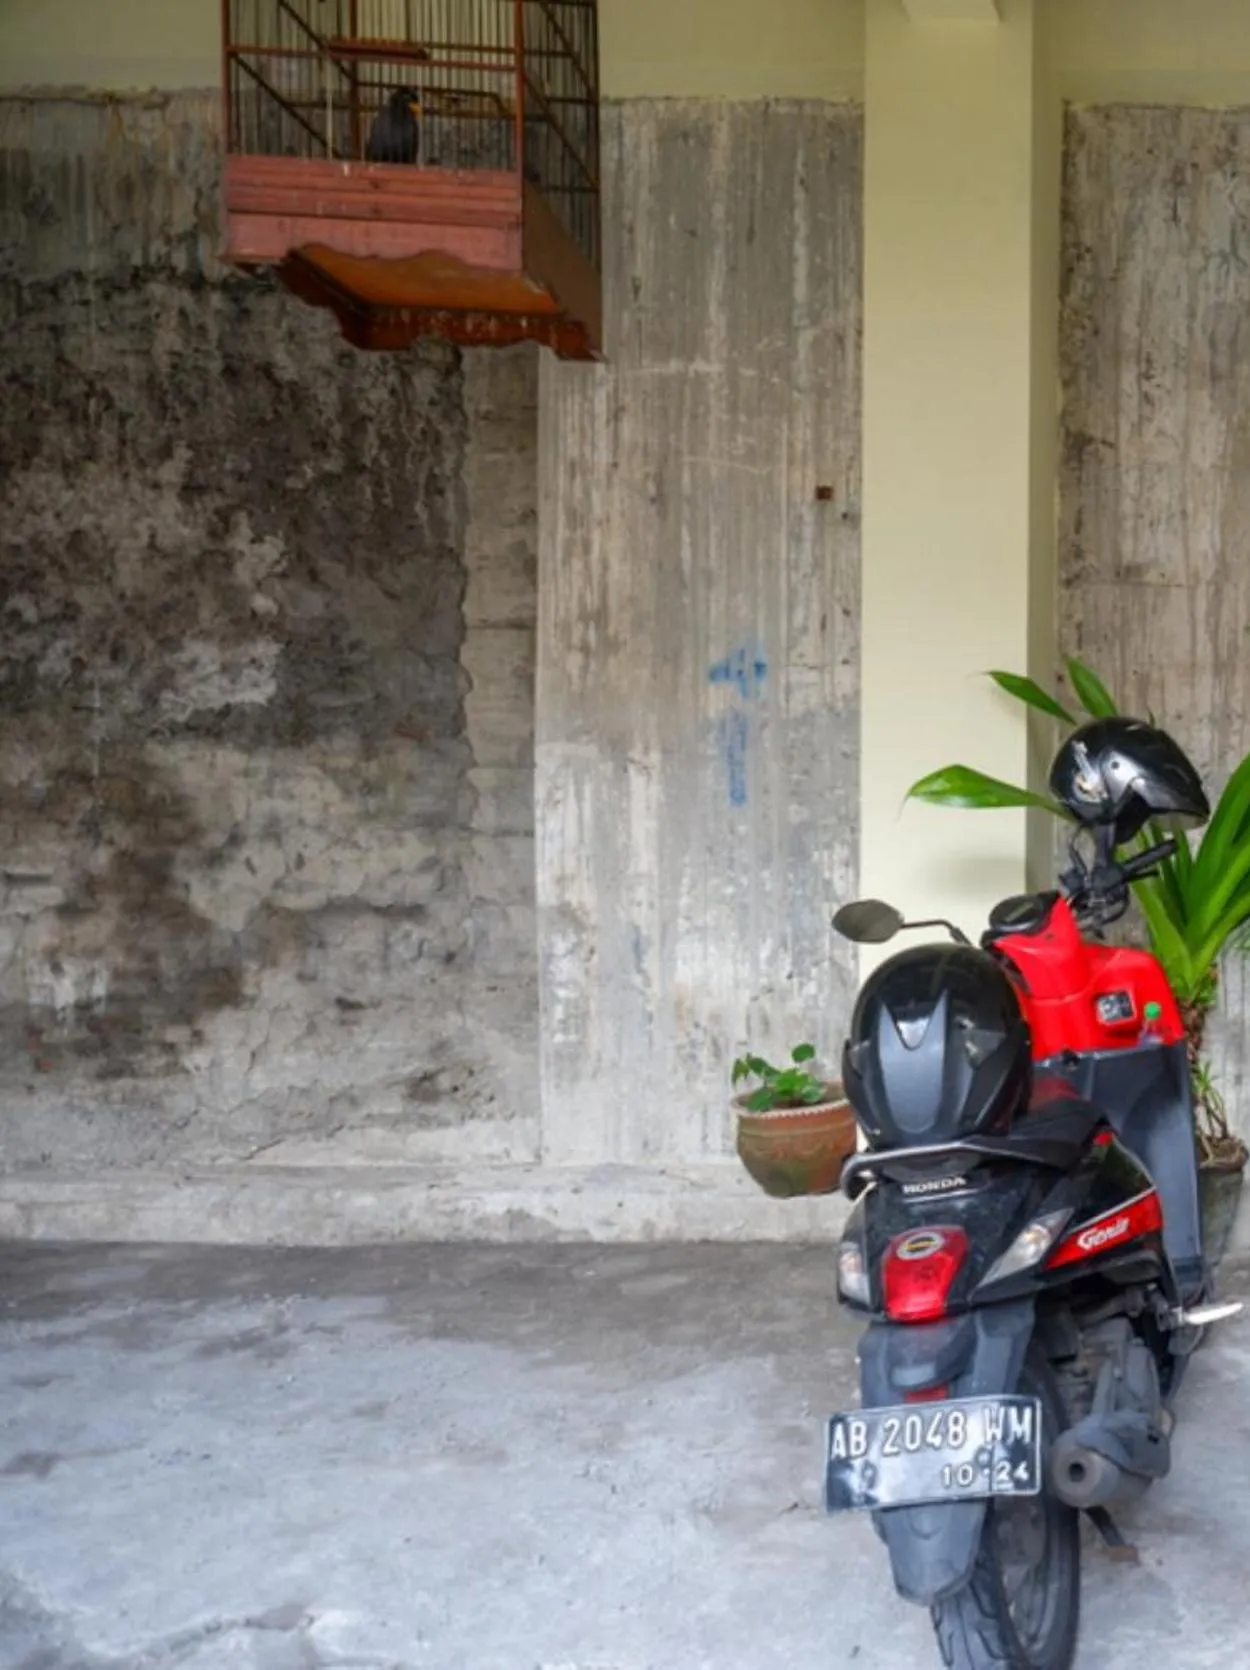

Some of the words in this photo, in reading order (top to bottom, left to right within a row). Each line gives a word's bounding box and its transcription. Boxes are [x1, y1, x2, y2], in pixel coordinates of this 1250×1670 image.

[903, 1177, 966, 1195] HONDA
[831, 1421, 868, 1460] AB
[883, 1411, 966, 1456] 2048
[983, 1406, 1032, 1445] WM
